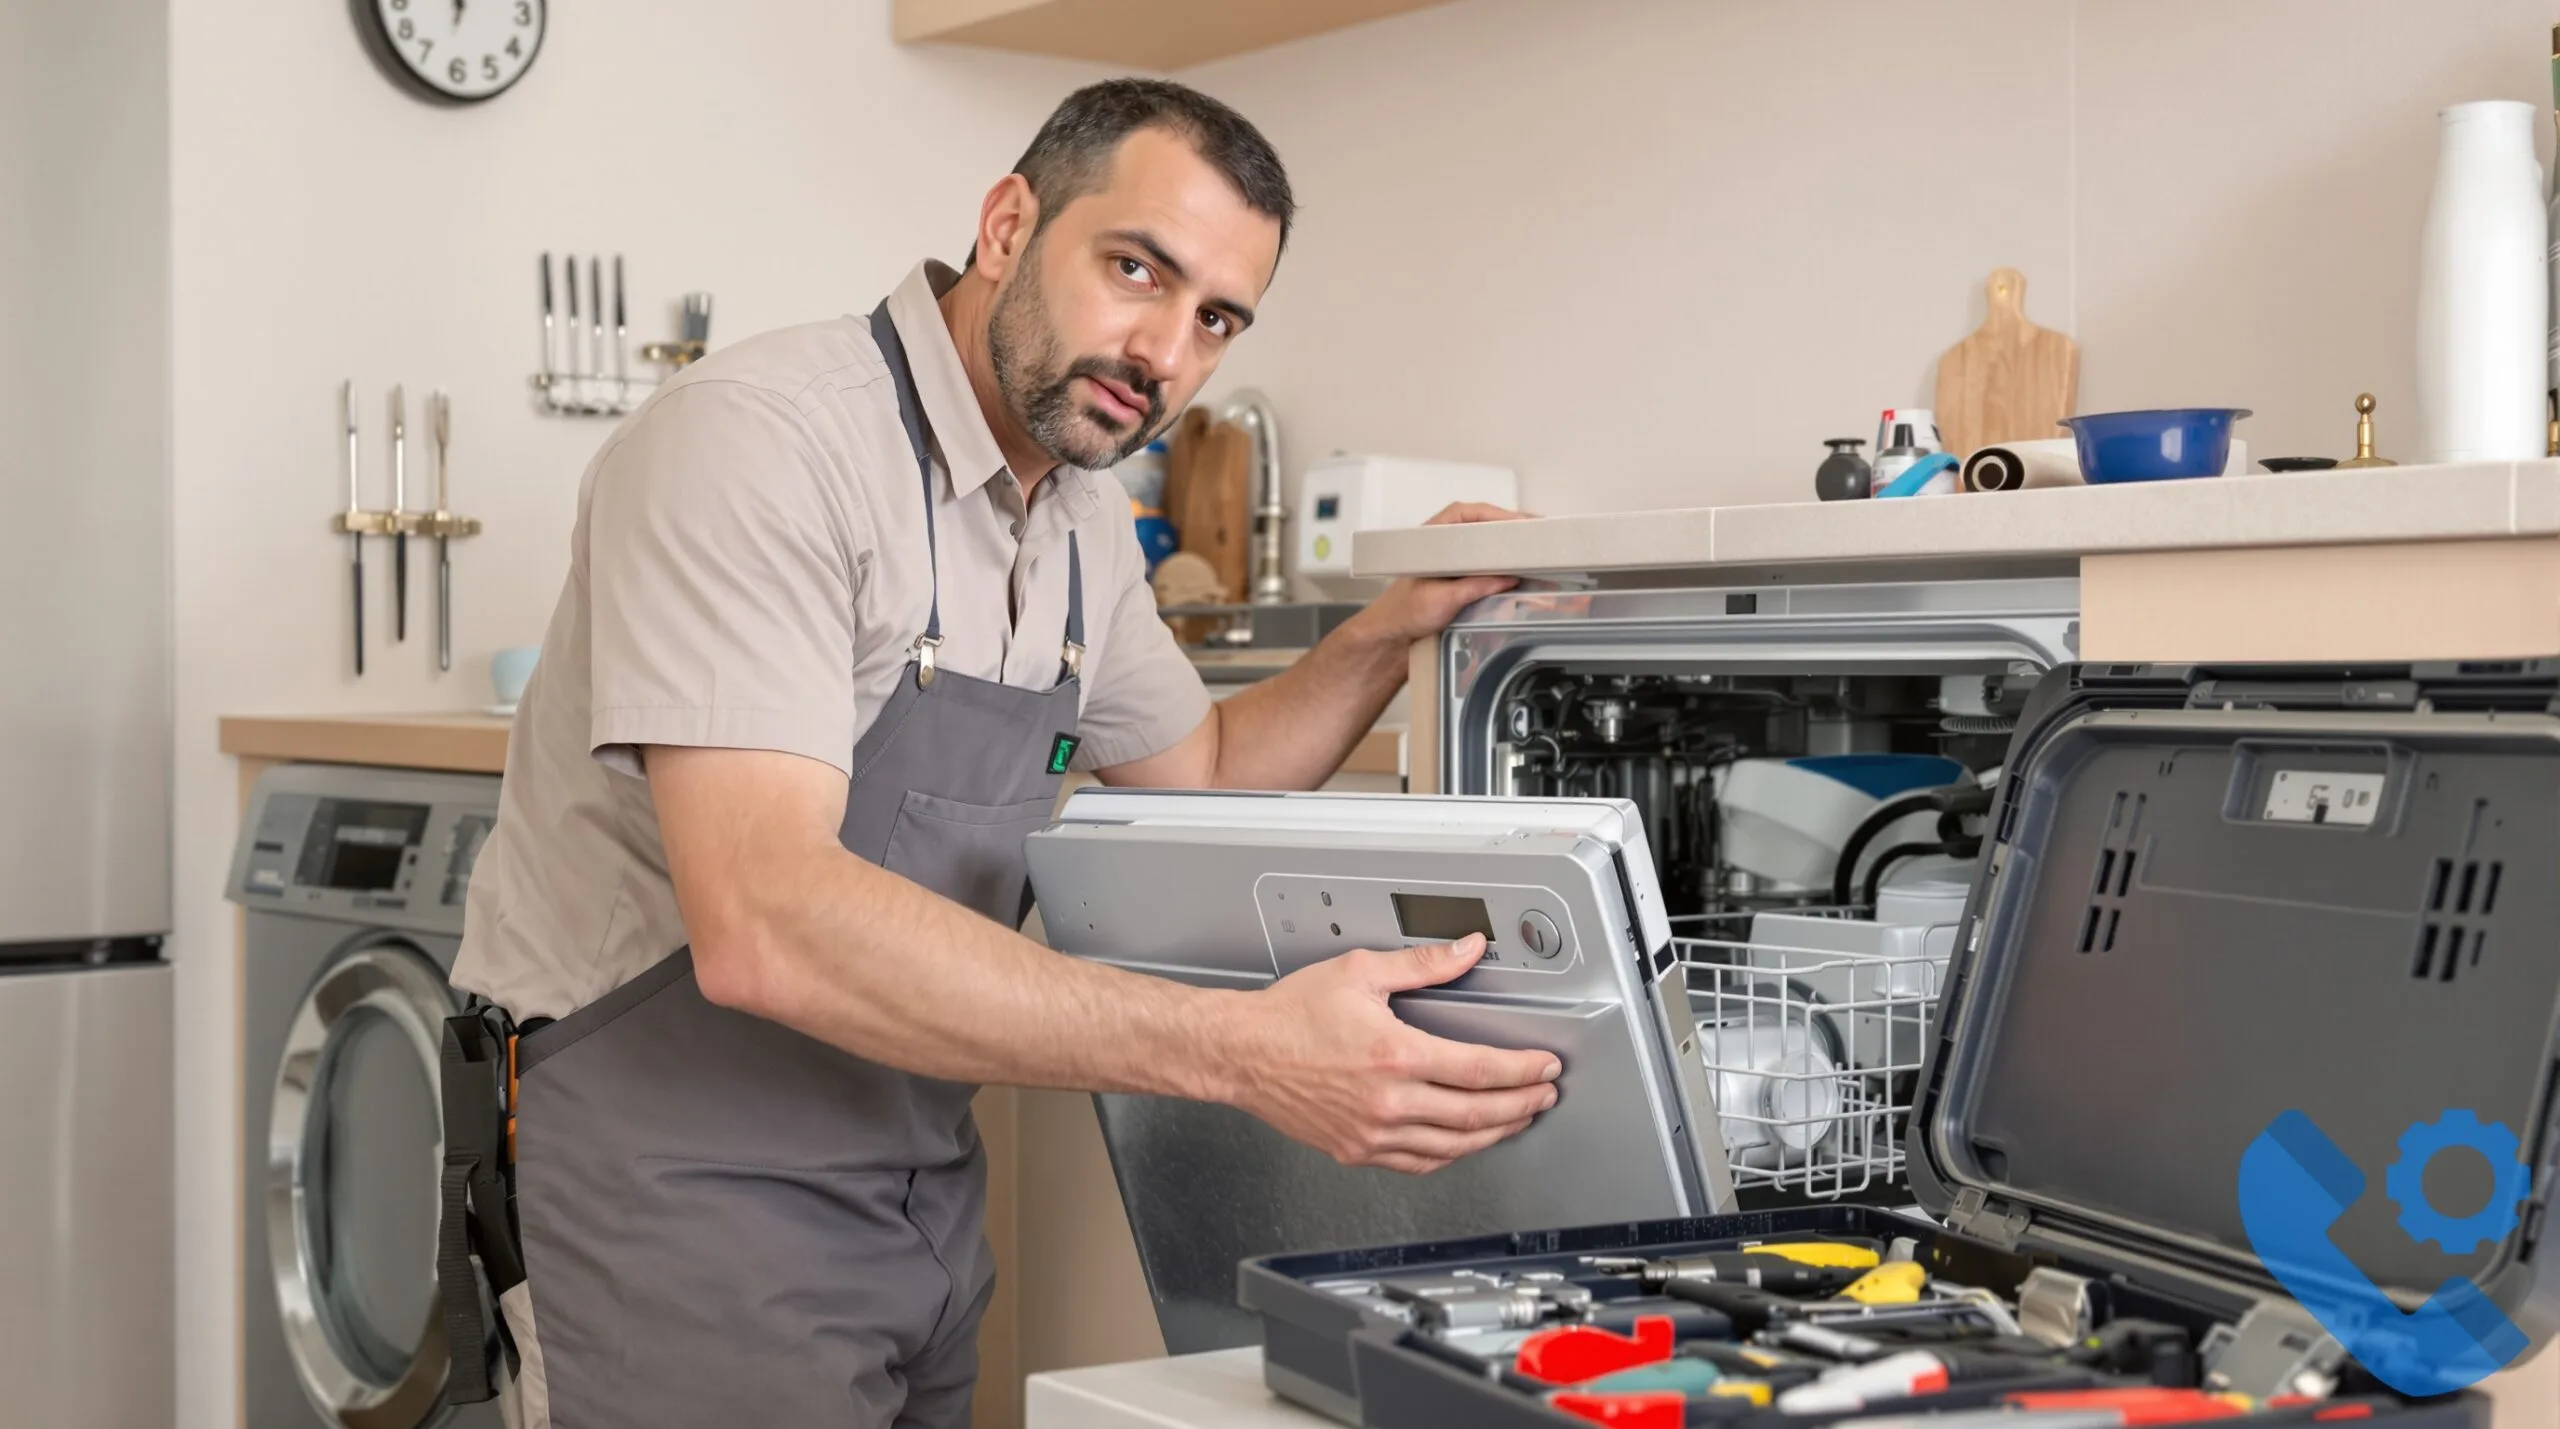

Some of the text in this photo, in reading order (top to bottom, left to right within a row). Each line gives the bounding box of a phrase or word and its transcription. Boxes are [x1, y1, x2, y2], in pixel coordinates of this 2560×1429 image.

[514, 1, 531, 26] 3
[398, 17, 414, 40] 8
[417, 37, 434, 64] 7
[505, 35, 521, 59] 4
[448, 57, 467, 83] 6
[482, 54, 498, 80] 5
